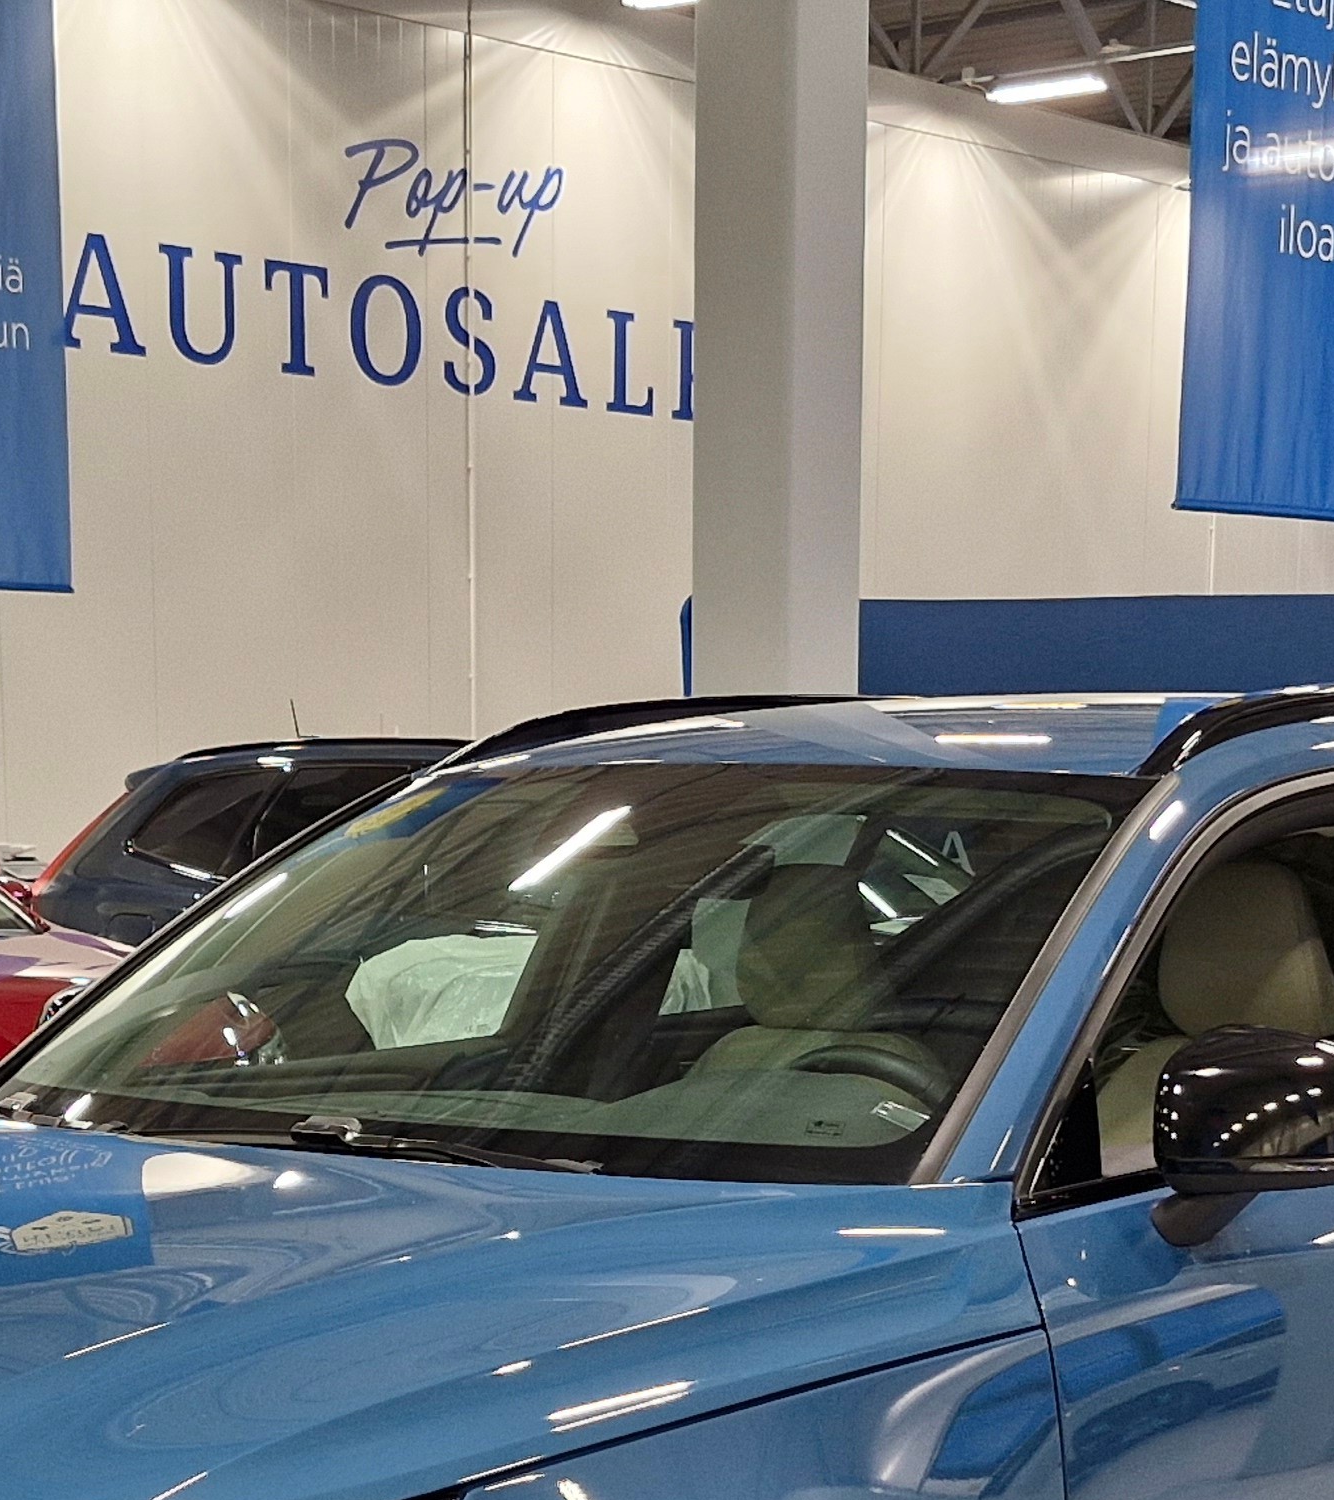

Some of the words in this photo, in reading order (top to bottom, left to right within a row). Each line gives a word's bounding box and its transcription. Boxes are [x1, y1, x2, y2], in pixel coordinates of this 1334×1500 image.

[1222, 110, 1251, 172] ja
[344, 138, 566, 257] Pop-up
[1278, 204, 1334, 262] iloa
